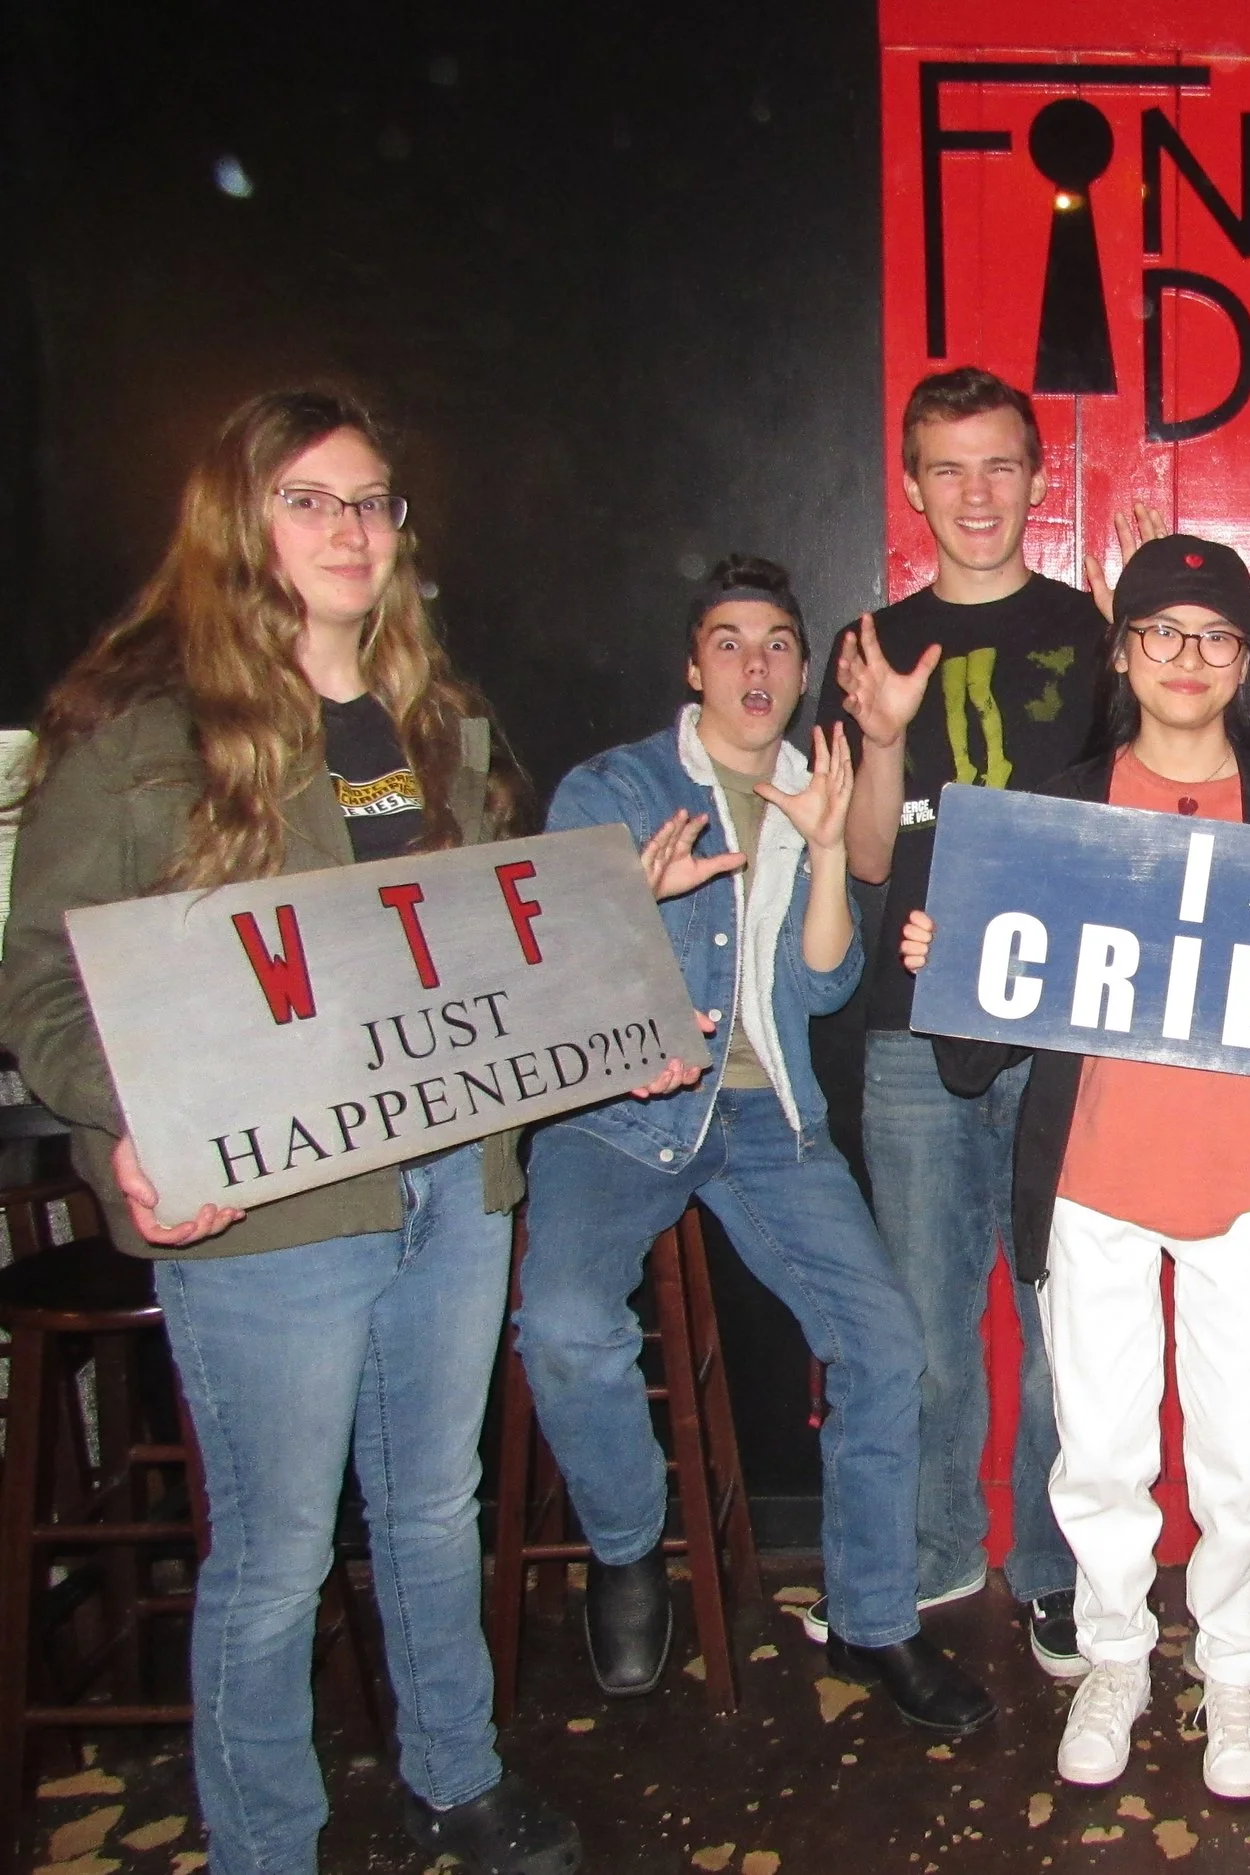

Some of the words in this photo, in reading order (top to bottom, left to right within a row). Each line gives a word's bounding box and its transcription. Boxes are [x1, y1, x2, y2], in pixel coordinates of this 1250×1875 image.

[915, 808, 936, 823] VEIL
[1178, 832, 1216, 924] I
[361, 990, 512, 1071] JUST
[208, 1018, 669, 1188] HAPPENED?!?!
